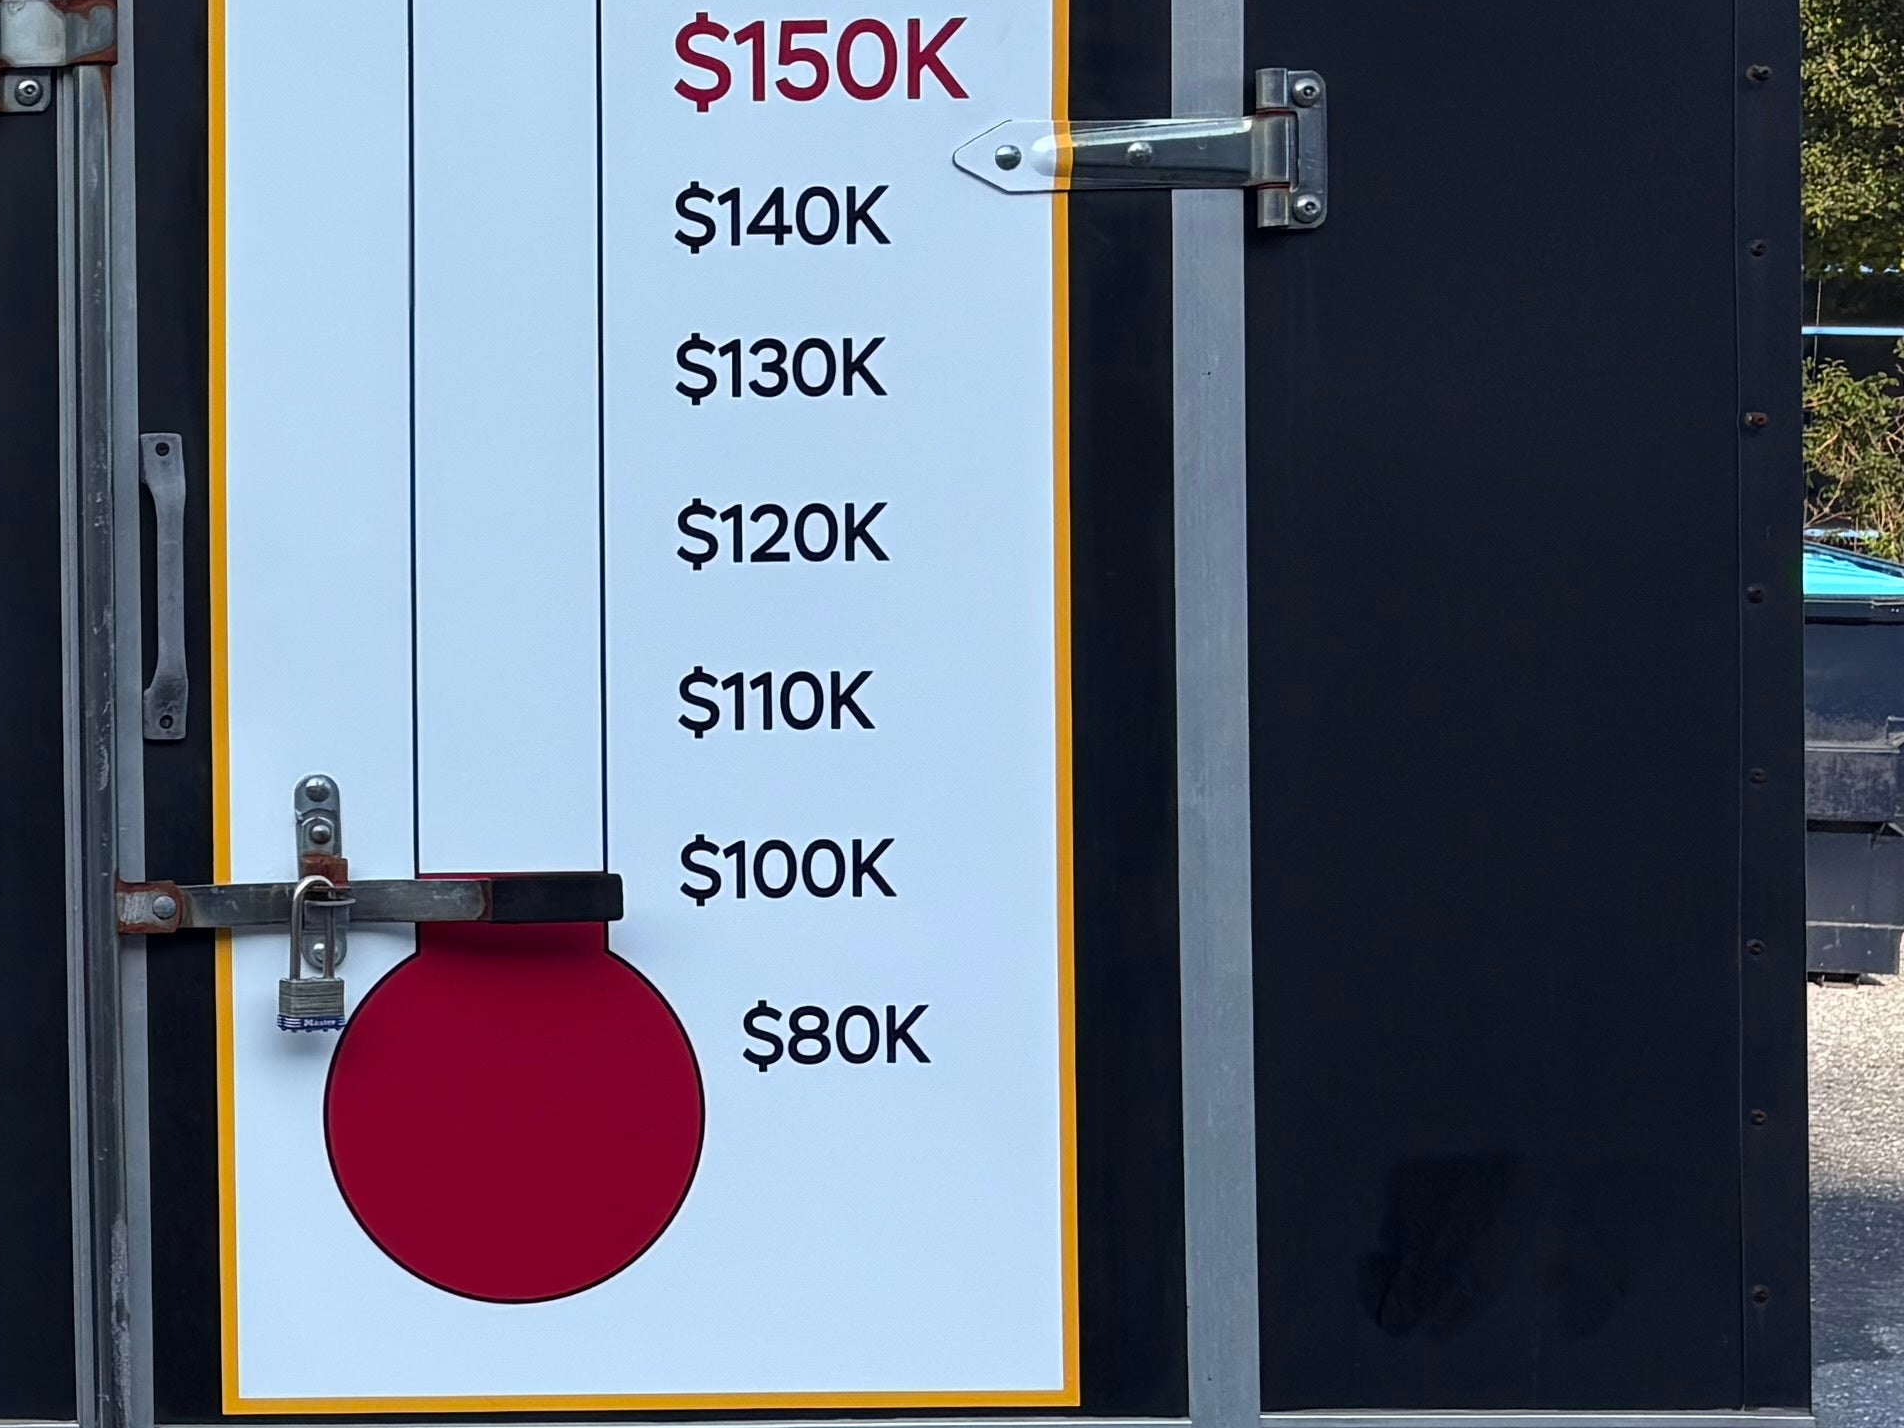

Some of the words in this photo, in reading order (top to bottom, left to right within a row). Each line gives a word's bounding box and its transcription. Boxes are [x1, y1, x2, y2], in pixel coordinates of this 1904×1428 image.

[673, 11, 970, 113] $150K
[674, 180, 892, 255] $140K
[675, 332, 888, 406] $130K
[676, 497, 890, 571] $120K
[678, 665, 876, 739] $110K
[680, 833, 897, 907] $100K
[742, 999, 932, 1073] $80K
